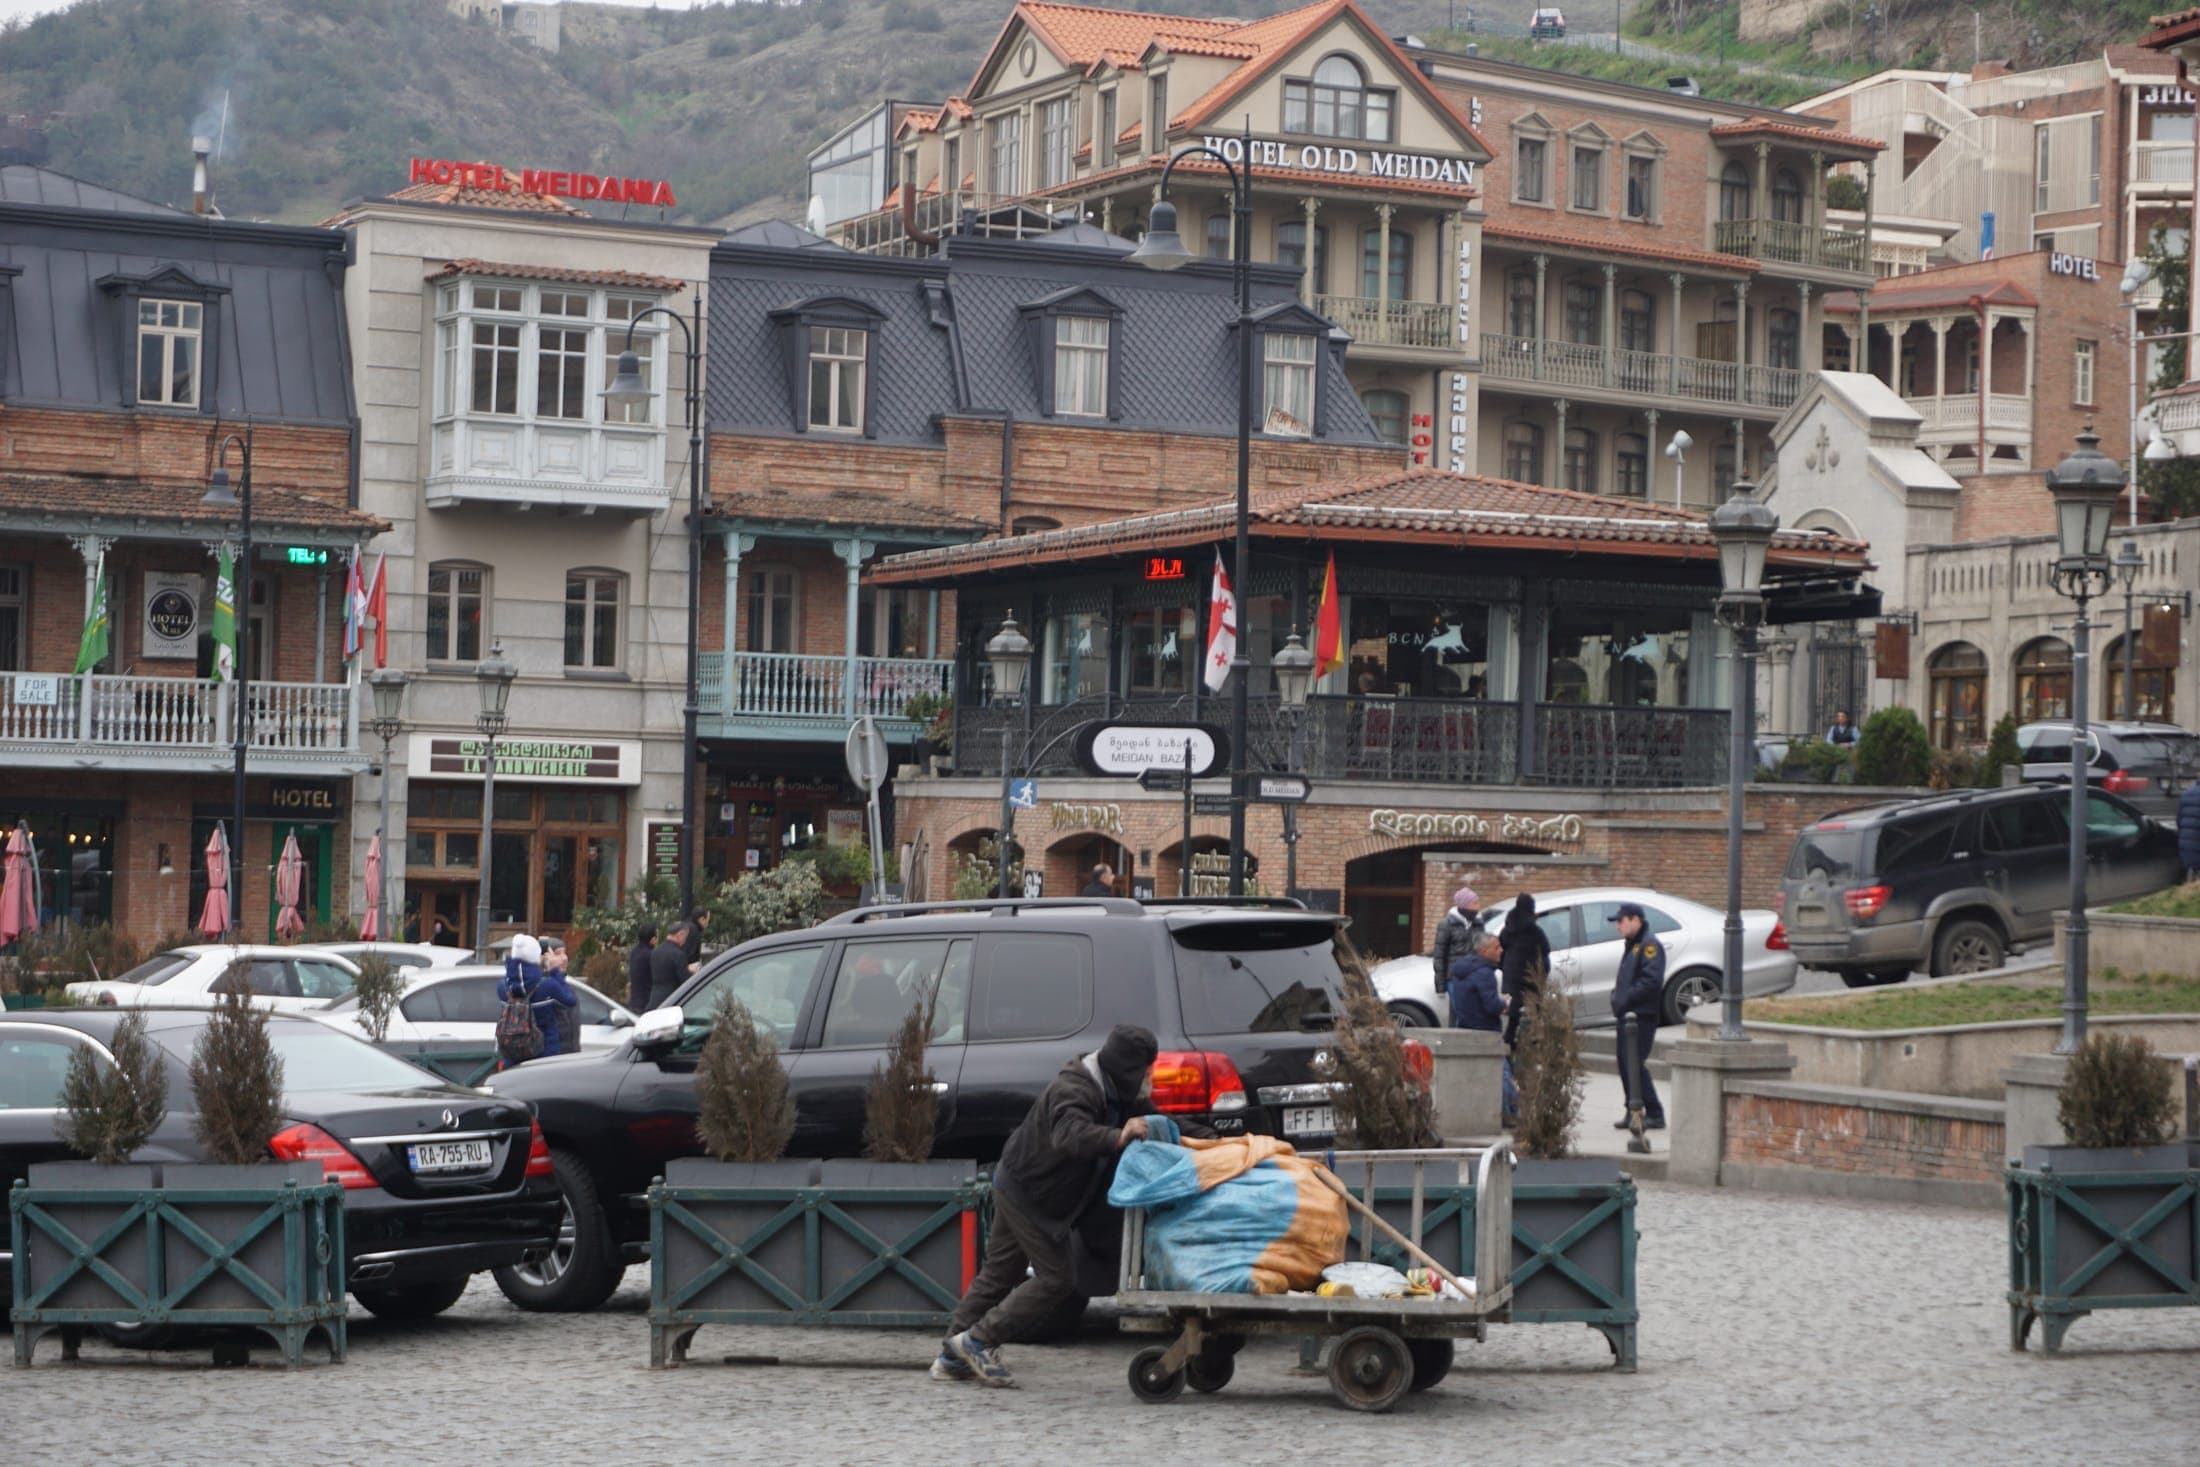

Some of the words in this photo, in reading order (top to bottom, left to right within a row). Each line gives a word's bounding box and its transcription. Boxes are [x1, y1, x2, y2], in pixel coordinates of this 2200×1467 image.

[1203, 136, 1291, 167] HOTEL
[1301, 145, 1358, 173] OLD
[1371, 151, 1475, 184] MEIDAN
[410, 157, 512, 191] HOTEL
[2051, 252, 2102, 281] HOTEL
[1412, 413, 1432, 465] HOT
[20, 690, 51, 701] SALE
[24, 679, 48, 690] FOR
[463, 758, 481, 773] LA
[495, 758, 588, 776] ANDWICHERIE
[1111, 753, 1154, 763] MEIDAN
[272, 788, 334, 809] HOTEL
[419, 1143, 483, 1166] RA-755-RU
